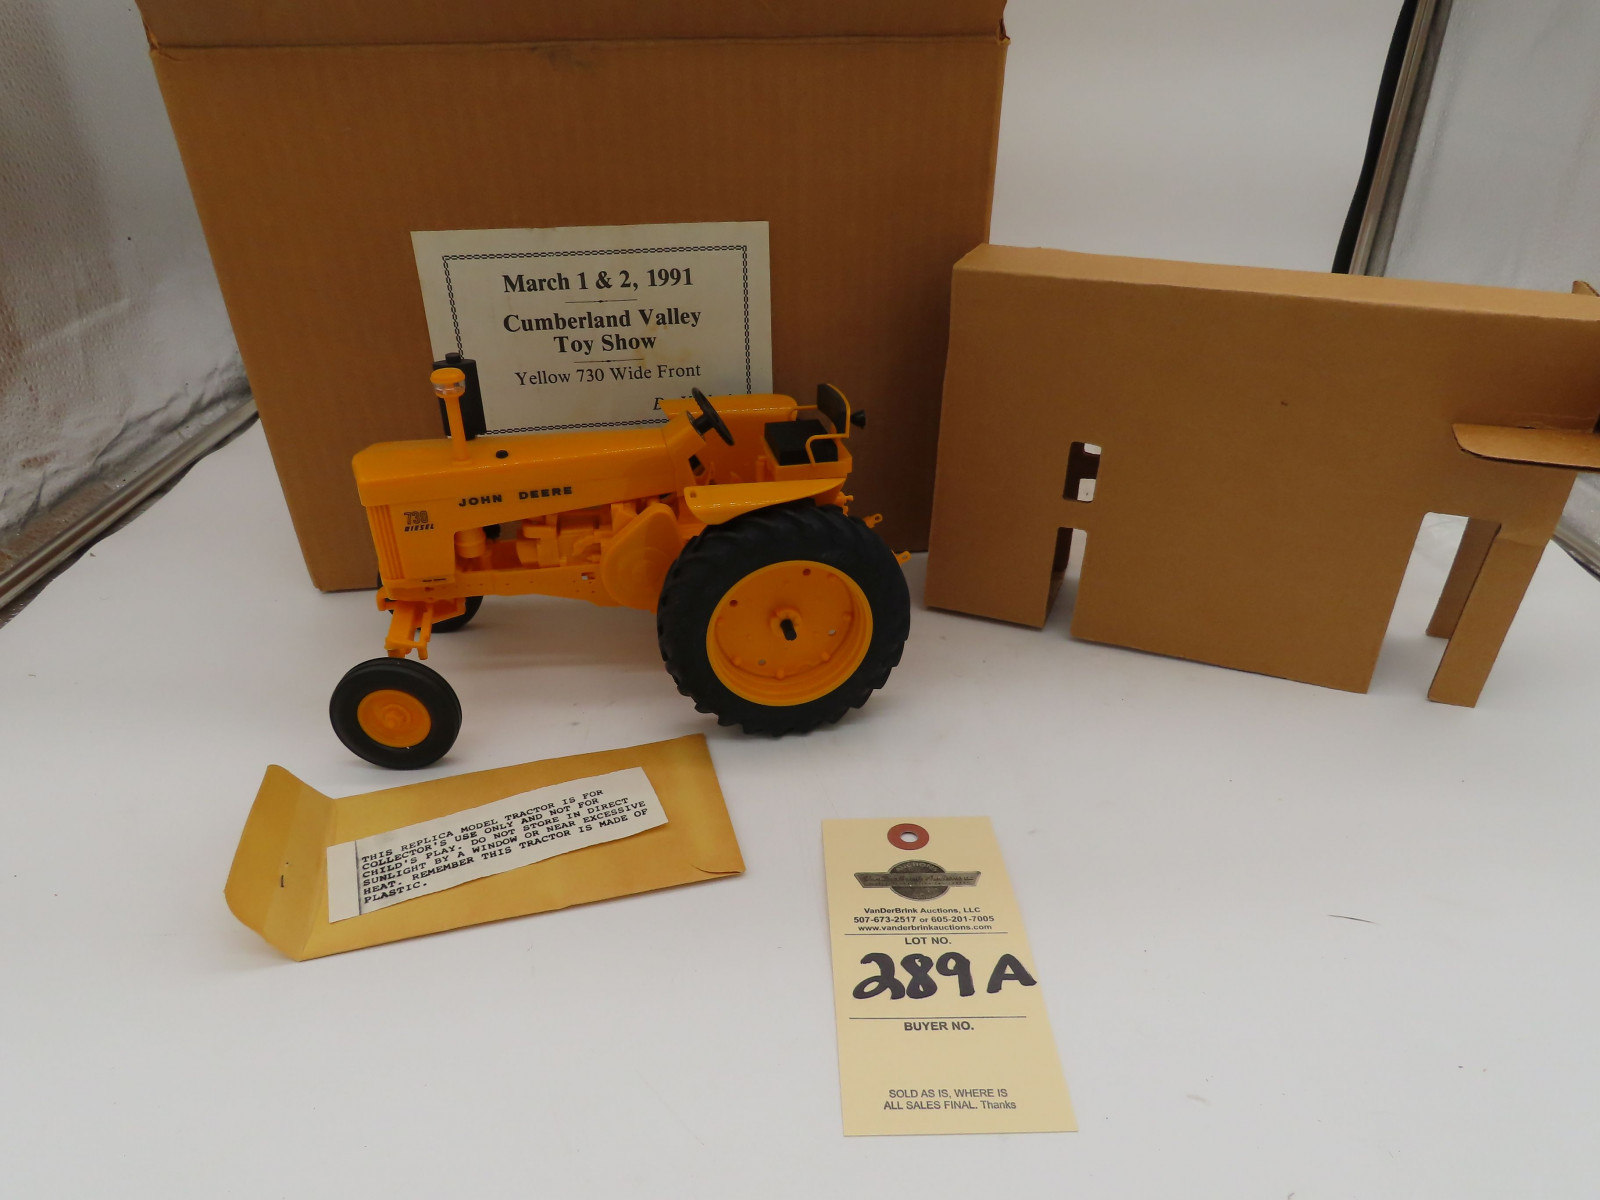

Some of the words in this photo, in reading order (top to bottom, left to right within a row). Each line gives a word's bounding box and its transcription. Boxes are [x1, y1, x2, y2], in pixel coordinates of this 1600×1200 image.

[502, 273, 570, 293] March
[577, 272, 588, 290] 1
[595, 270, 612, 289] &
[619, 270, 638, 291] 2,
[647, 267, 694, 287] 1991
[503, 310, 631, 332] Cumberland
[638, 307, 701, 328] Valley
[553, 336, 594, 356] Toy
[602, 333, 656, 352] Show
[515, 370, 571, 386] Yellow
[576, 368, 605, 383] 730
[609, 366, 652, 381] Wide
[657, 364, 702, 379] Front
[458, 494, 503, 507] JOHN
[518, 486, 573, 500] DEERE
[403, 510, 429, 525] 730
[404, 523, 435, 532] DIESEL
[361, 849, 393, 863] THIS
[401, 830, 454, 851] REPLICA
[460, 819, 499, 833] MODEL
[505, 802, 555, 821] TRACTOR
[562, 797, 576, 805] IS
[582, 789, 604, 800] FOR
[362, 839, 447, 870] COLLECTOR'S
[455, 831, 478, 842] USE
[484, 821, 514, 834] ONLY
[521, 813, 543, 824] AND
[550, 805, 571, 815] NOT
[577, 798, 599, 809] FOR
[362, 857, 418, 878] CHILD'S
[426, 845, 462, 859] PLAY.
[471, 836, 486, 846] DO
[493, 828, 516, 839] NOT
[523, 816, 559, 832] STORE
[567, 811, 581, 819] IN
[587, 797, 628, 814] DIRECT
[363, 862, 427, 886] SUNLIGHT
[434, 855, 449, 865] BY
[472, 836, 518, 853] WINDOW
[525, 830, 539, 839] OR
[546, 820, 576, 833] NEAR
[583, 801, 646, 823] EXCESSIVE
[363, 880, 402, 895] HEAT.
[412, 857, 474, 880] REMEMBER
[481, 846, 512, 860] THIS
[519, 830, 571, 849] TRACTOR
[578, 824, 593, 833] IS
[599, 815, 629, 828] MADE
[634, 808, 648, 817] OF
[364, 881, 427, 904] PLASTIC.
[853, 916, 916, 924] 507-673-2517
[858, 924, 992, 932] www.vanderbrinkauctions.com
[904, 937, 927, 945] LOT
[931, 936, 952, 945] NO.
[853, 951, 975, 1000] 289
[986, 953, 1037, 994] A
[904, 1021, 948, 1031] BUYER
[952, 1021, 974, 1031] NO.
[889, 1089, 918, 1098] SOLD
[920, 1089, 935, 1098] AS
[938, 1089, 951, 1099] IS,
[954, 1088, 994, 1098] WHERE
[997, 1088, 1008, 1097] IS
[883, 1101, 903, 1110] ALL
[906, 1101, 941, 1109] SALES
[944, 1101, 978, 1109] FINAL.
[980, 1100, 1017, 1109] Thanks
